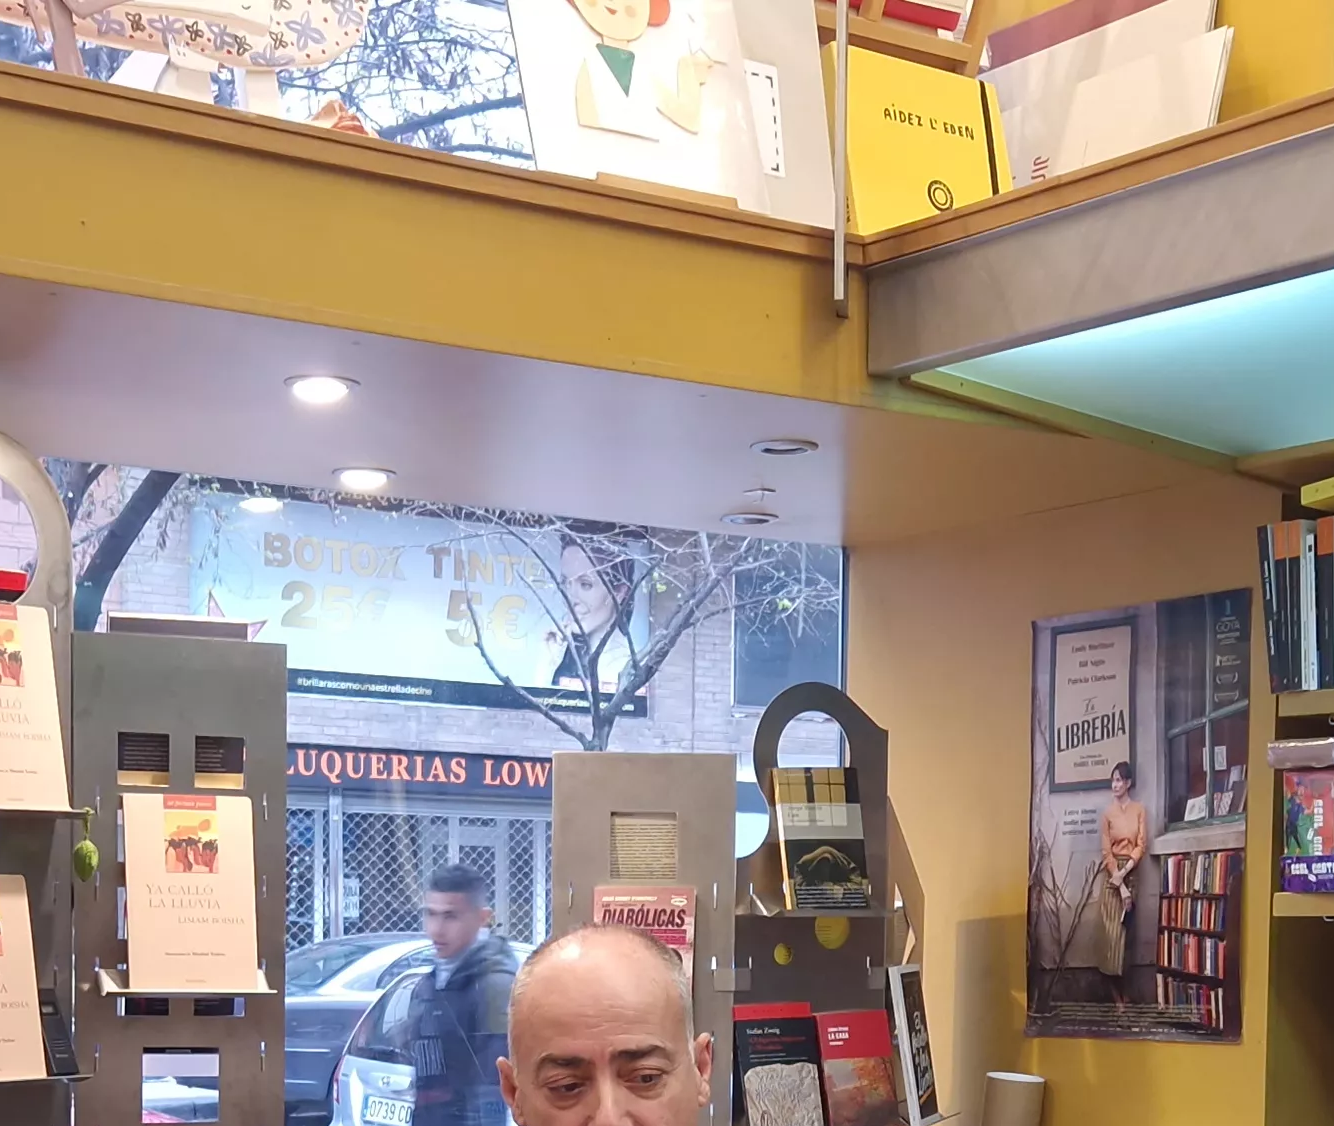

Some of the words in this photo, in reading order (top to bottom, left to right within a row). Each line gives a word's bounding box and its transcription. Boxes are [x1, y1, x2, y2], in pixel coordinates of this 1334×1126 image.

[943, 121, 976, 142] EDEN
[263, 531, 406, 580] BOTOX
[426, 544, 549, 588] TINTE
[445, 590, 528, 647] 5€
[1068, 677, 1090, 686] Patricia
[1091, 673, 1117, 683] Clarkson
[1057, 704, 1126, 753] LIBRERÍA
[287, 749, 467, 784] UQUERIAS
[483, 759, 552, 788] LOW
[146, 883, 164, 896] YA
[167, 883, 214, 897] CALLÓ
[148, 897, 167, 909] LA
[170, 898, 221, 911] LLUVIA
[602, 904, 687, 928] DIABÓLICAS
